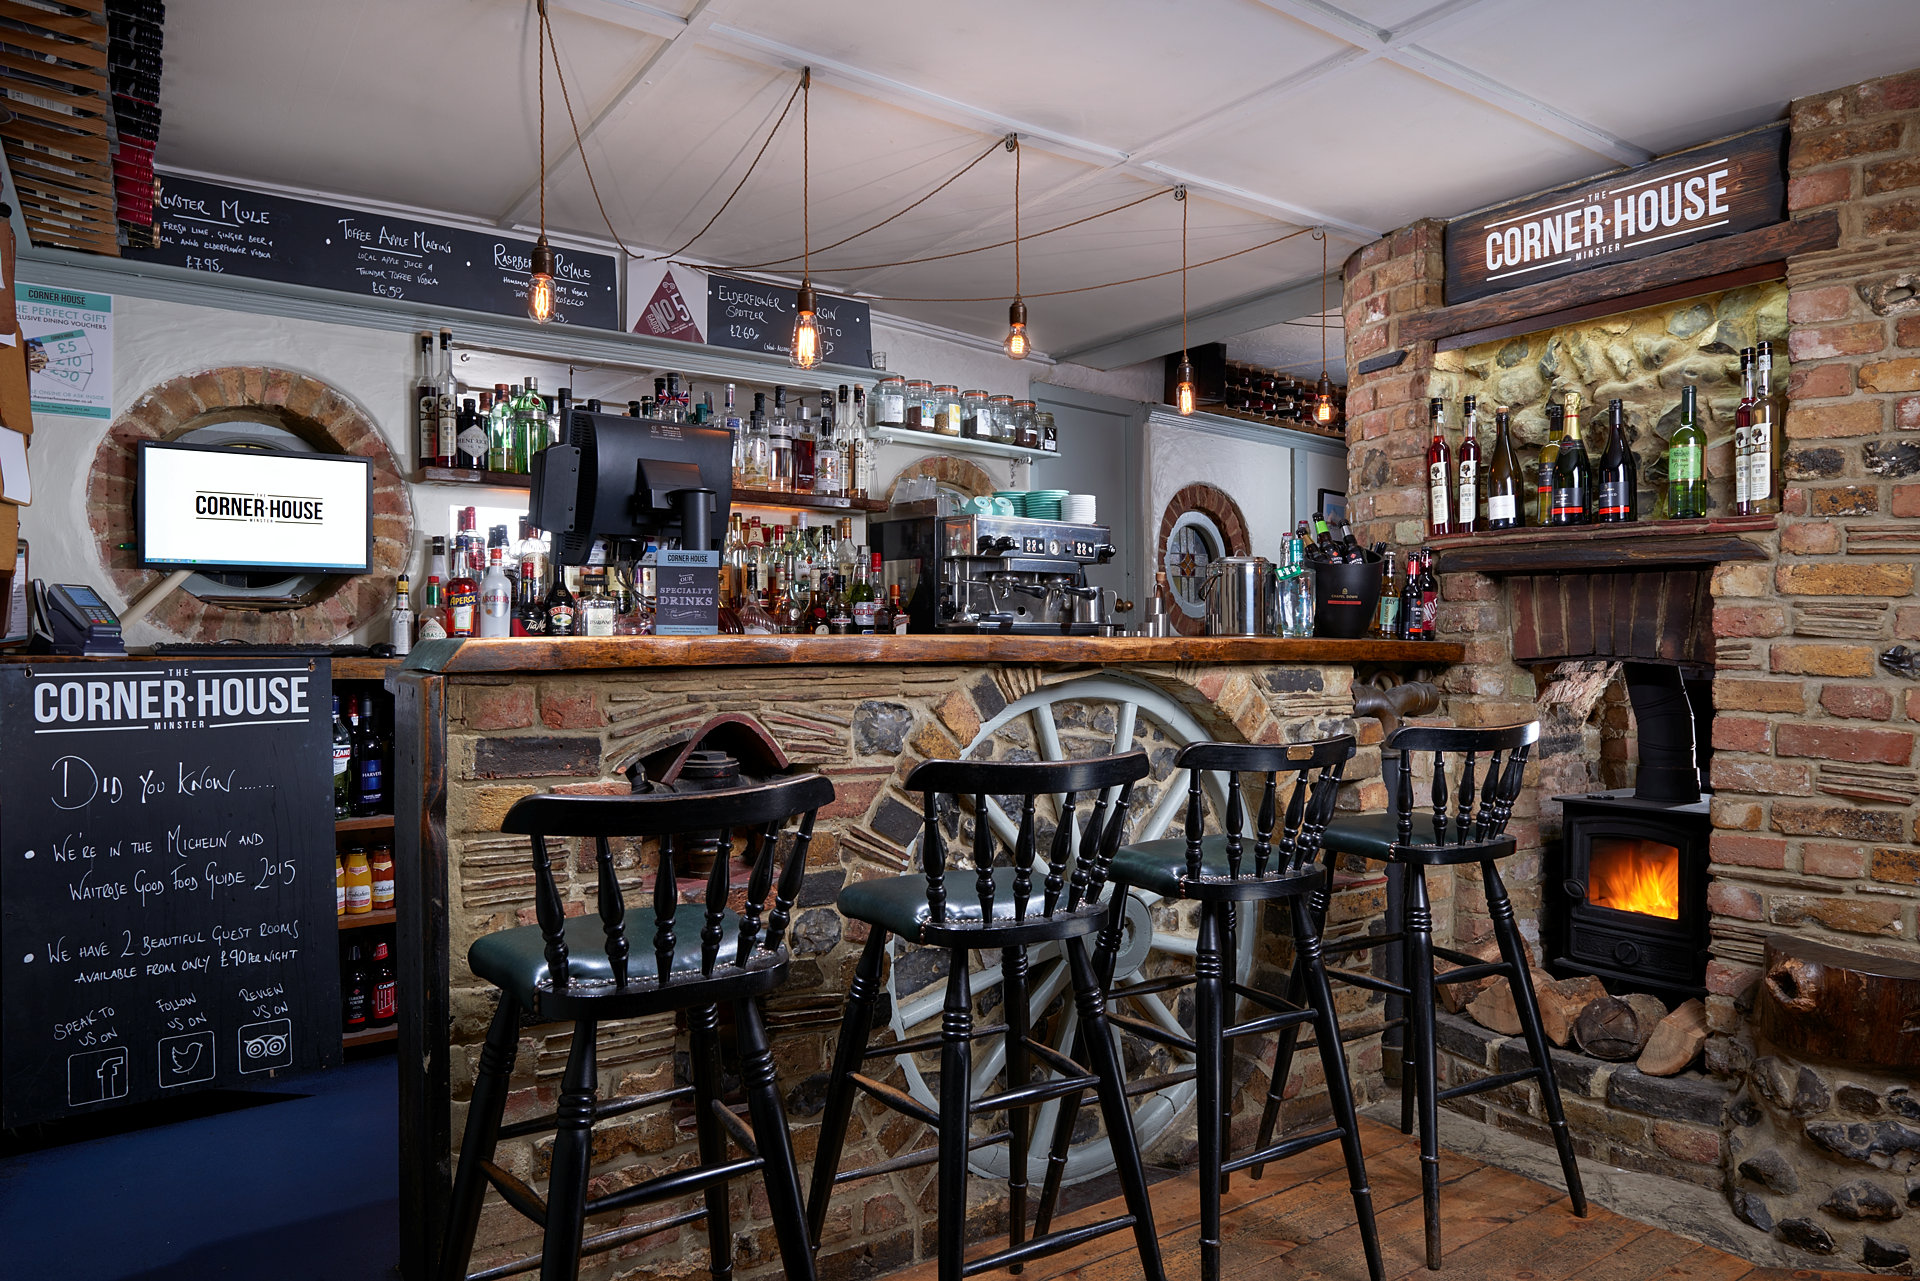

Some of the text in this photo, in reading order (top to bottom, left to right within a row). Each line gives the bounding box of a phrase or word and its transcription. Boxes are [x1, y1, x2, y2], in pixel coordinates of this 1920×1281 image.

[1588, 190, 1607, 203] THE
[221, 200, 270, 224] MULE
[1486, 169, 1729, 271] CORNER HOUSE
[163, 222, 187, 234] FRESH
[217, 231, 243, 241] GINGER
[248, 236, 267, 246] BEER
[338, 218, 452, 253] TOFFEE APPLE MARTINI
[204, 242, 247, 254] ELDERFLOWER
[250, 250, 271, 258] VODKA
[1575, 243, 1621, 261] MINSTER
[358, 252, 377, 261] LOCAL
[382, 256, 399, 264] APPLE
[404, 260, 423, 268] JUICE
[494, 243, 592, 278] RASPBER ROYALE
[389, 270, 412, 281] TOFFEE
[417, 273, 439, 285] VODKA
[28, 289, 86, 306] CORNER HOUSE
[571, 288, 588, 297] VODKA
[718, 285, 786, 313] ELDERFLOWER
[32, 306, 79, 320] PERFECT
[83, 313, 107, 324] GIFT
[650, 298, 676, 333] NO
[671, 292, 690, 322] 5
[726, 305, 768, 324] SPRITZER
[816, 304, 840, 321] RGIN
[43, 317, 70, 325] DINING
[71, 321, 107, 330] VOUCHERS
[818, 324, 842, 337] JITO
[57, 341, 77, 354] £5
[195, 495, 324, 520] CORNER HOUSE
[449, 594, 477, 606] APEROL
[660, 587, 713, 595] SPECIALITY
[660, 596, 713, 606] DRINKS
[168, 668, 190, 677] THE
[34, 676, 309, 723] CORNER HOUSE
[154, 720, 206, 731] MINSTER
[51, 755, 123, 809] DID
[139, 769, 165, 804] YOU
[53, 824, 264, 862] WE'RE IN THE MICHELIN AND
[69, 857, 297, 907] WAITROSE GOOD FOOD GUIDE 2015
[47, 919, 300, 963] WE HAVE 2 BEAUTIFUL GUEST ROOMS
[74, 968, 138, 984] AVAILABLE
[146, 962, 176, 975] FROM
[182, 955, 211, 973] ONLY
[220, 948, 248, 968] £90
[264, 949, 298, 963] NIGHT
[238, 983, 284, 1002] REVIEW
[155, 993, 197, 1013] FOLLOW
[252, 1001, 289, 1019] US ON
[53, 1006, 115, 1040] SPEAK TO
[167, 1012, 207, 1031] US ON
[79, 1028, 118, 1046] US ON
